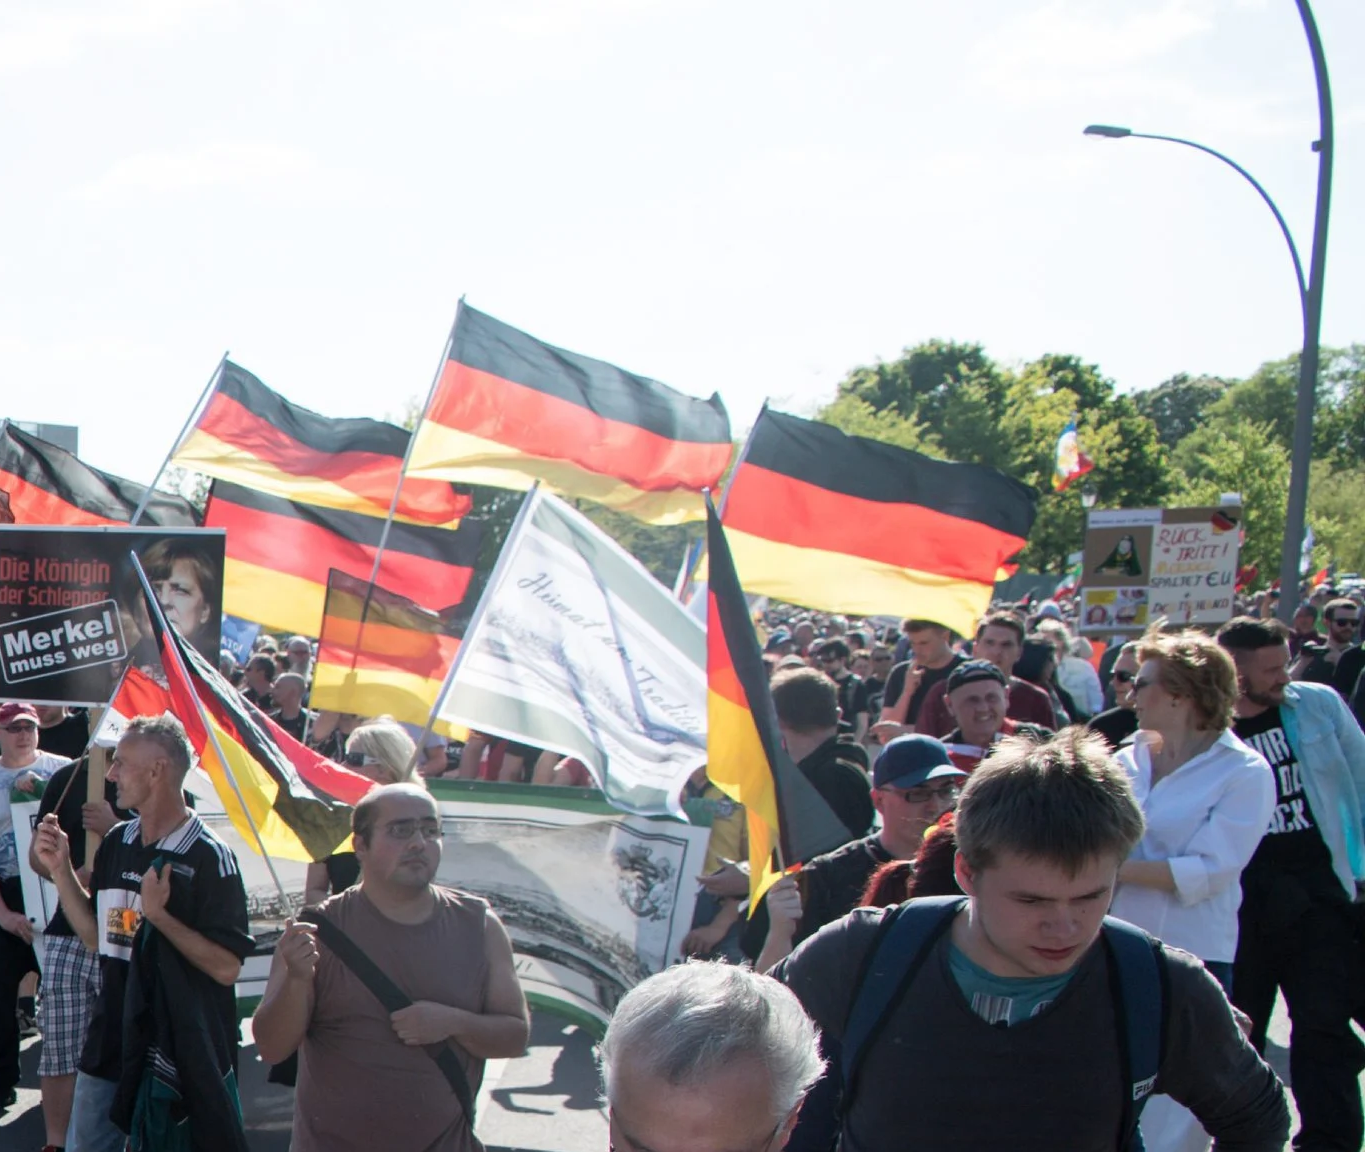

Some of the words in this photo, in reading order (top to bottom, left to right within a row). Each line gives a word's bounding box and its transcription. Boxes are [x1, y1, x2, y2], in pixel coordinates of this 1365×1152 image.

[0, 557, 29, 582] Die
[34, 557, 111, 585] Königin
[3, 611, 115, 658] Merkel
[9, 650, 67, 675] muss
[71, 639, 120, 661] weg
